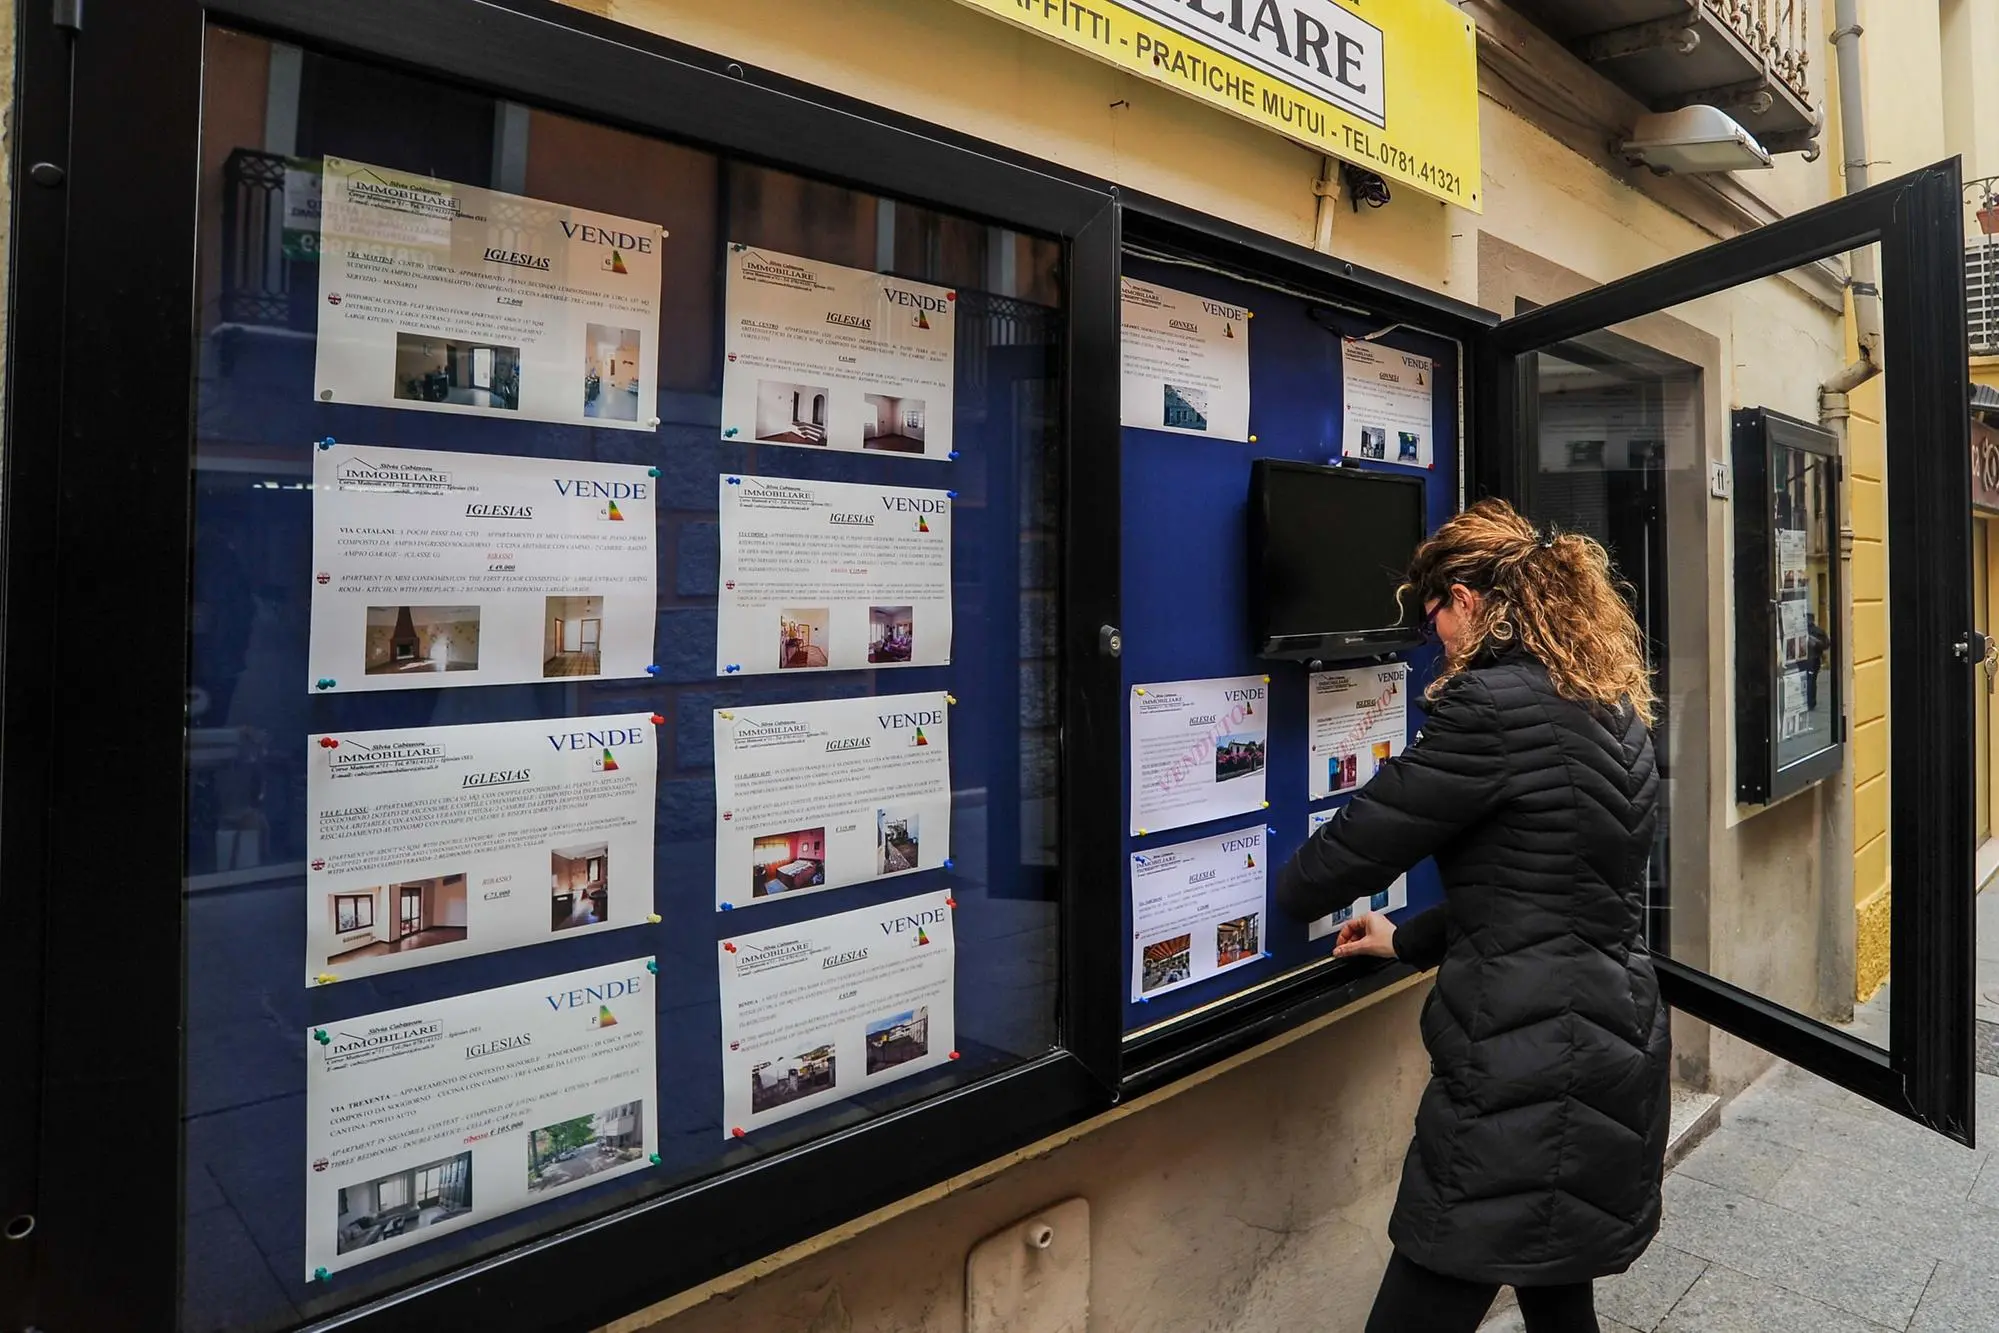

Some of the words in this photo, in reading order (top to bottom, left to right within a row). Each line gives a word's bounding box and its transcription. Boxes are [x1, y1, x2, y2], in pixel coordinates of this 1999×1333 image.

[1137, 31, 1255, 107] PRATICHE
[1262, 89, 1325, 137] MUTUI
[1342, 125, 1461, 196] TEL.0781.41321
[355, 180, 456, 208] IMMOBILIARE
[558, 219, 652, 254] VENDE
[483, 246, 550, 271] IGLESIAS
[747, 261, 814, 281] IMMOBILIARE
[883, 287, 946, 313] VENDE
[825, 311, 871, 330] IGLESIAS
[1202, 301, 1242, 321] VENDE
[1402, 356, 1429, 371] VENDE
[345, 469, 447, 482] IMMOBILIARE
[1717, 468, 1725, 491] 11
[553, 478, 647, 499] VENDE
[744, 488, 809, 499] IMMOBILIARE
[465, 503, 532, 519] IGLESIAS
[881, 496, 945, 513] VENDE
[829, 512, 874, 526] IGLESIAS
[1377, 670, 1405, 683] VENDE
[1225, 688, 1264, 702] VENDE
[878, 710, 942, 729] VENDE
[547, 727, 643, 752] VENDE
[738, 724, 806, 737] IMMOBILIARE
[825, 736, 871, 752] IGLESIAS
[337, 746, 440, 763] IMMOBILIARE
[462, 768, 530, 788] IGLESIAS
[1221, 834, 1261, 852] VENDE
[880, 907, 944, 936] VENDE
[741, 941, 808, 964] IMMOBILIARE
[822, 947, 868, 969] IGLESIAS
[545, 975, 641, 1013] VENDE
[333, 1023, 437, 1054] IMMOBILIARE
[465, 1031, 531, 1060] IGLESIAS
[330, 1104, 345, 1114] VIA
